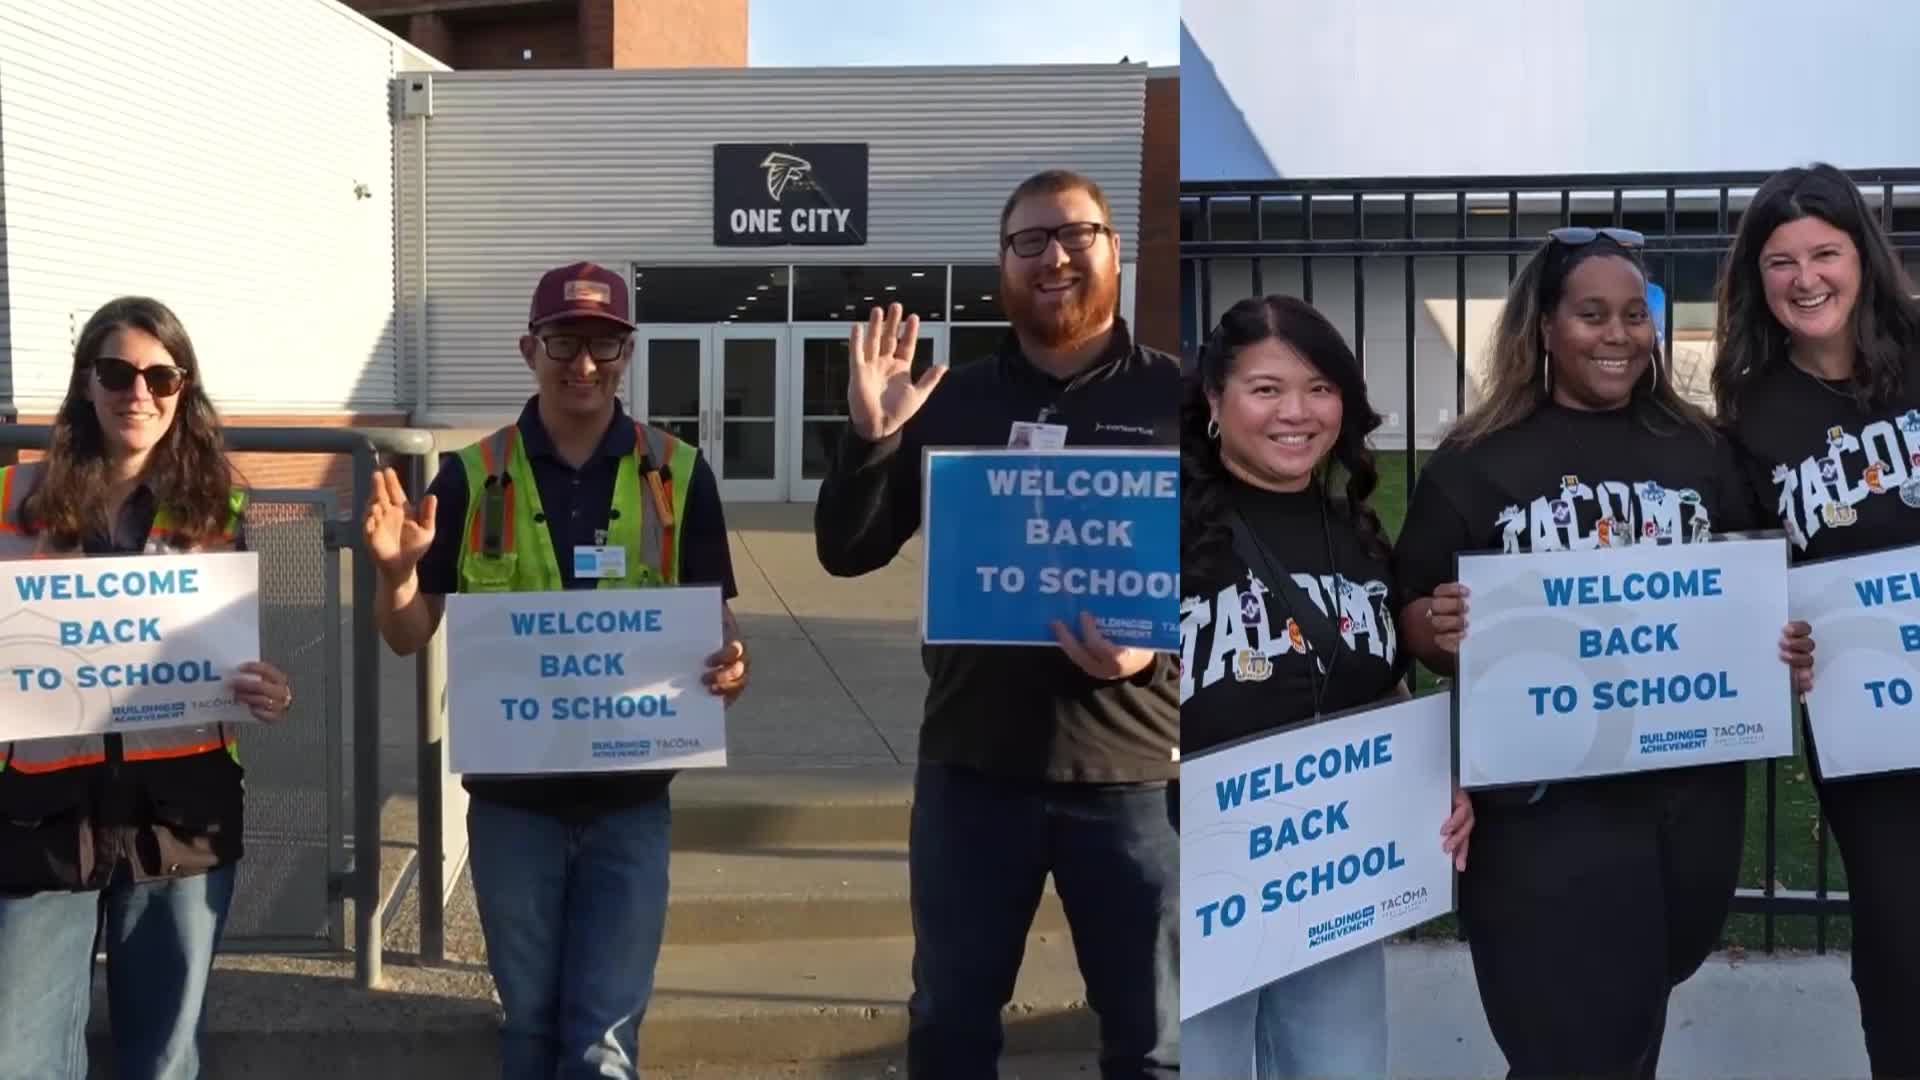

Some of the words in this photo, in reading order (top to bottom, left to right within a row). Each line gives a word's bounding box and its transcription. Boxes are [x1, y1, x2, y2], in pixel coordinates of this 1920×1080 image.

[730, 208, 782, 232] ONE
[790, 208, 851, 232] CITY
[986, 469, 1177, 498] WELCOME
[1026, 519, 1133, 547] BACK
[15, 569, 199, 600] WELCOME
[976, 566, 1025, 593] TO
[1543, 568, 1722, 606] WELCOME
[59, 618, 161, 646] BACK
[510, 609, 662, 636] WELCOME
[1579, 623, 1679, 658] BACK
[12, 668, 61, 691] TO
[77, 661, 221, 688] SCHOOL
[540, 654, 624, 678] BACK
[500, 698, 539, 721] TO
[551, 695, 677, 721] SCHOOL
[1528, 685, 1577, 716] TO
[1592, 671, 1738, 710] SCHOOL
[1864, 678, 1913, 708] TO
[1640, 730, 1694, 744] BUILDING
[1712, 723, 1764, 737] TACOMA
[1640, 739, 1707, 754] ACHIEVEMENT
[1215, 733, 1393, 811] WELCOME
[1248, 801, 1349, 860] BACK
[1195, 894, 1245, 937] TO
[1261, 841, 1405, 912] SCHOOL
[1308, 909, 1361, 938] BUILDING
[1381, 886, 1428, 912] TACOMA
[1308, 918, 1375, 948] ACHIEVEMENT
